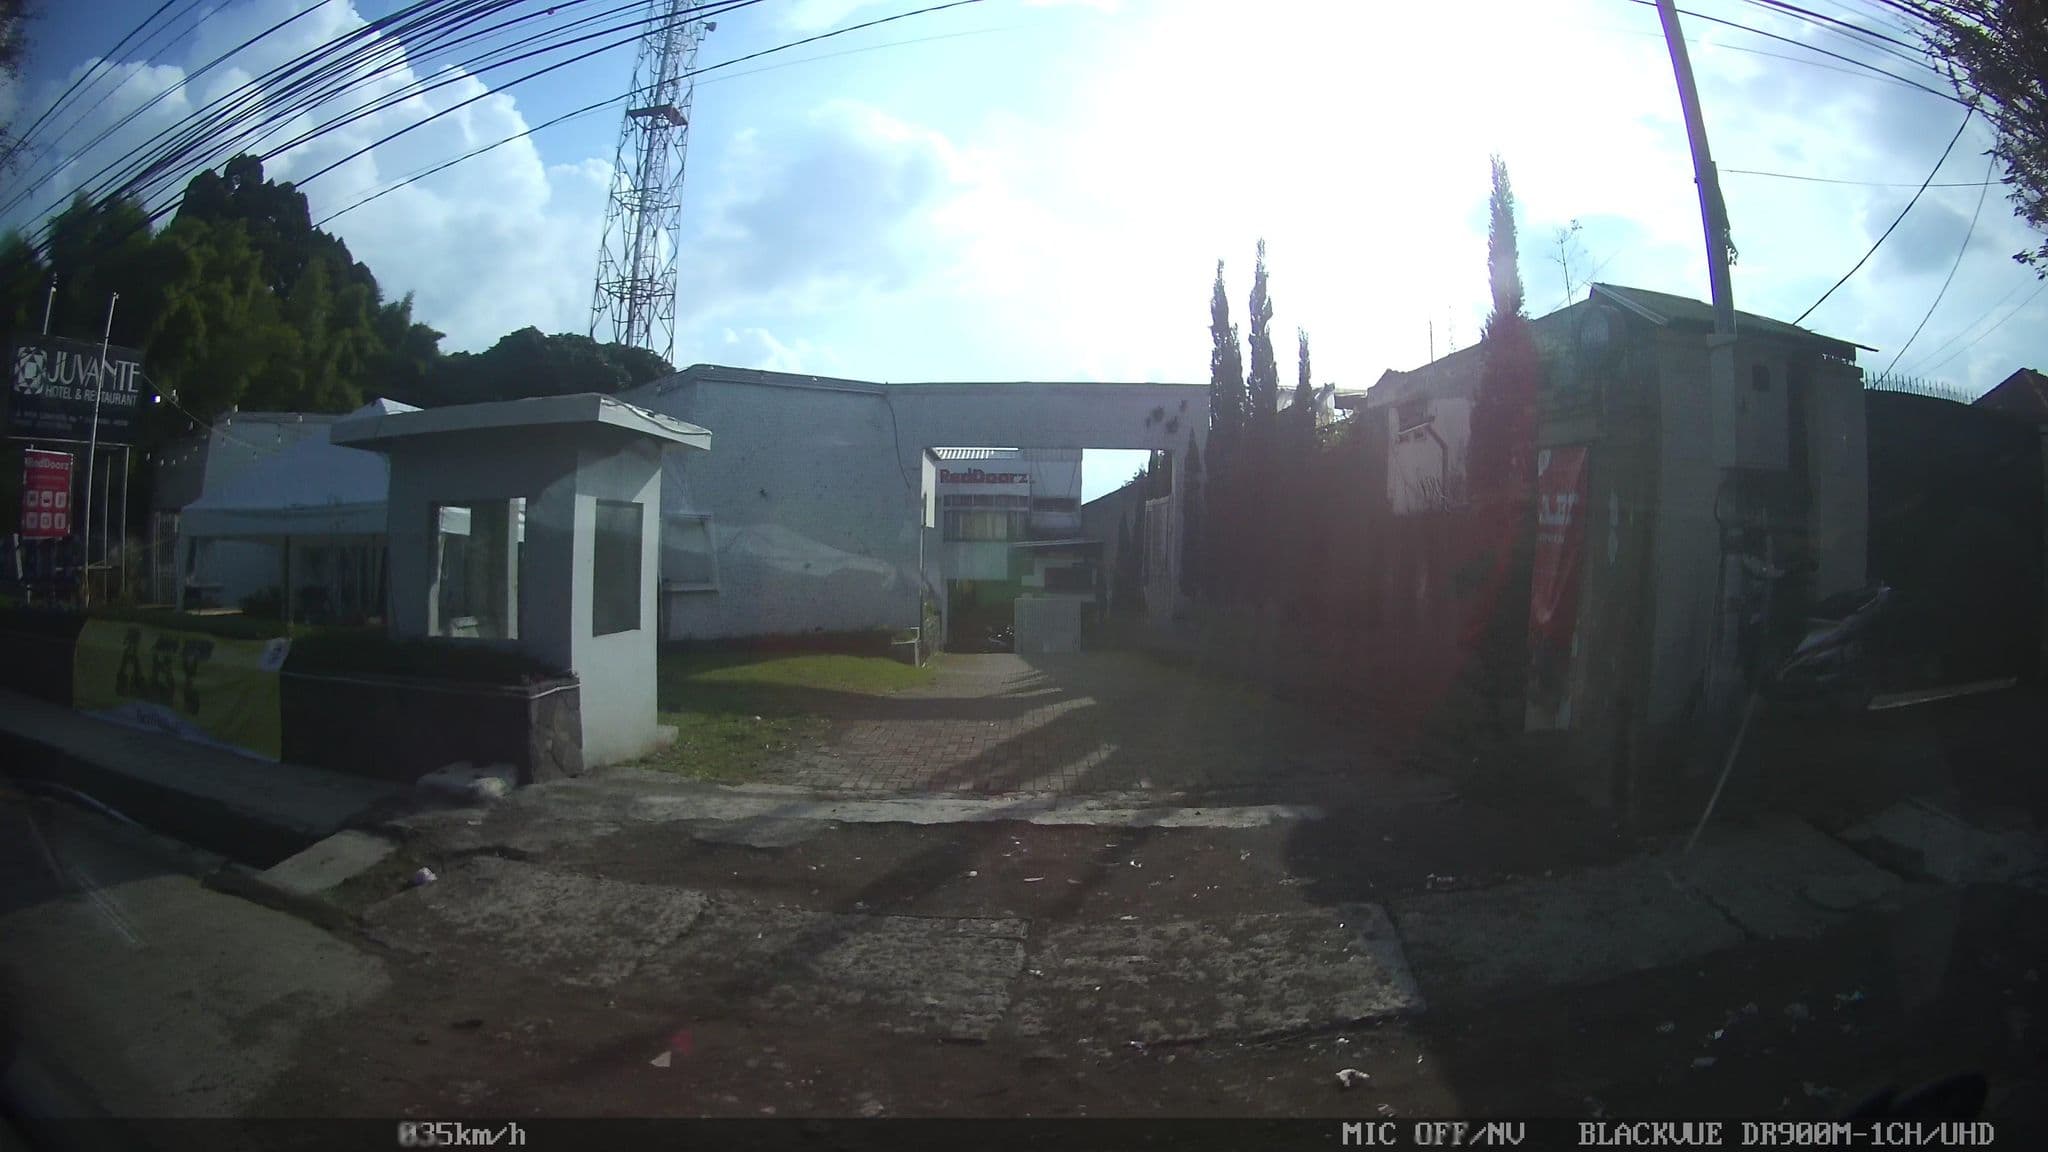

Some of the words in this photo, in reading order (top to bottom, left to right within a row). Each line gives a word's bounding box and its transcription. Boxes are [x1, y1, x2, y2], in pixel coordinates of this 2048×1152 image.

[48, 351, 140, 393] JUVANTE
[45, 385, 73, 400] HOTEL
[75, 388, 82, 401] &
